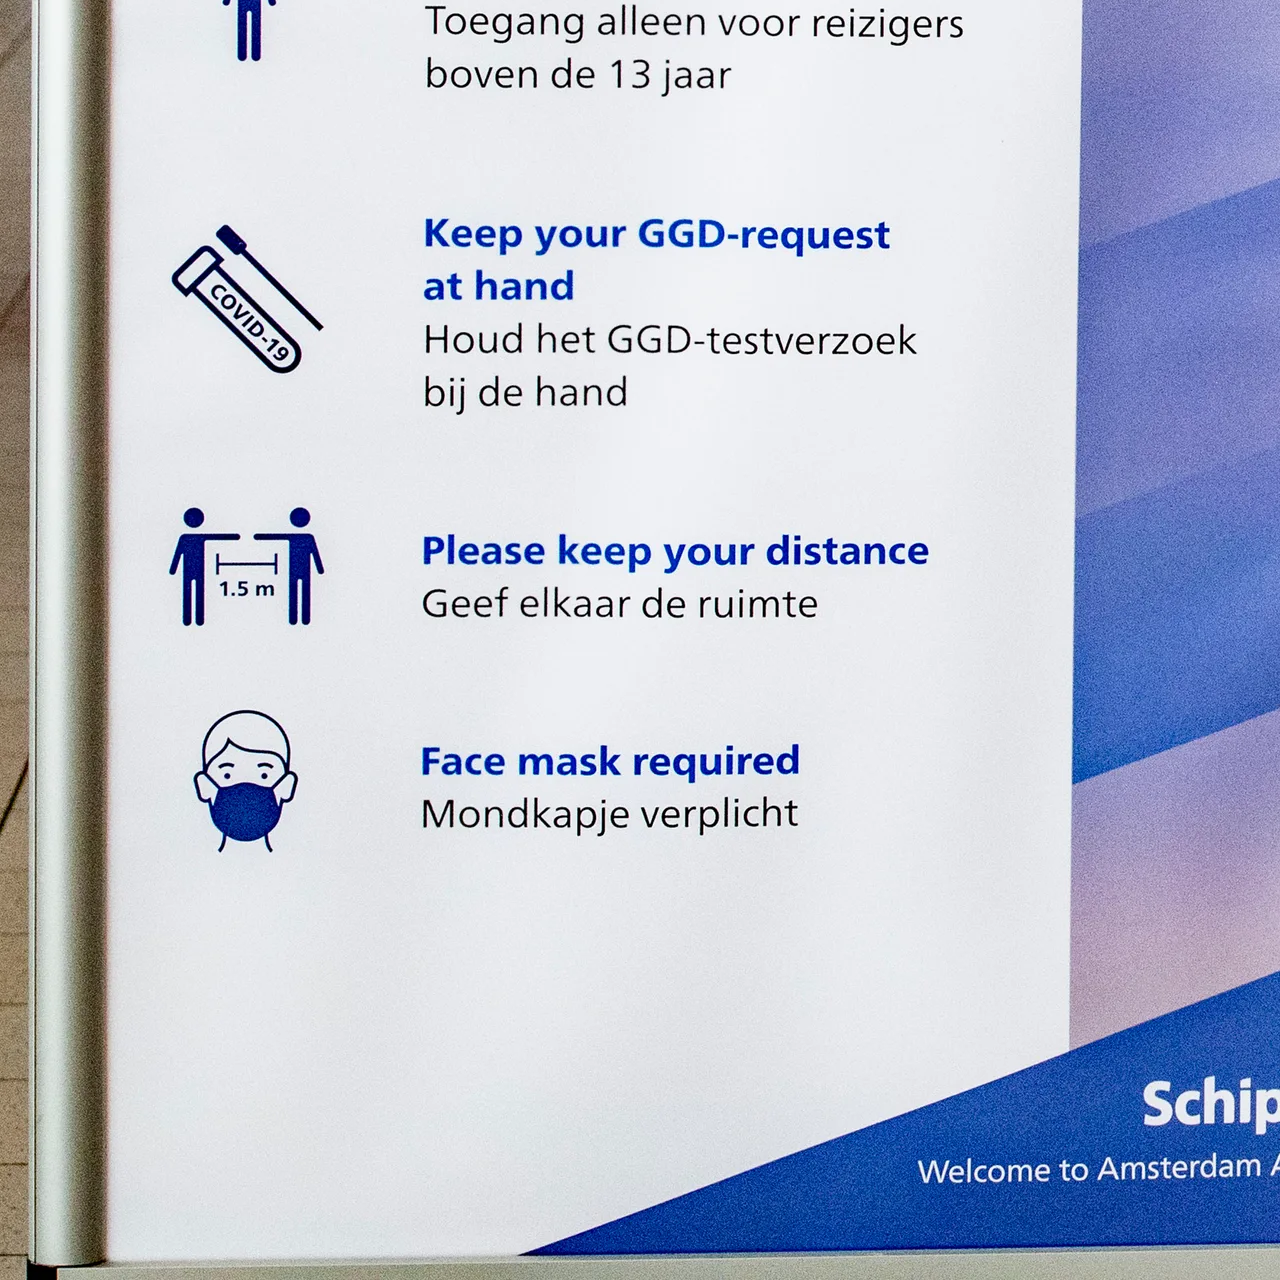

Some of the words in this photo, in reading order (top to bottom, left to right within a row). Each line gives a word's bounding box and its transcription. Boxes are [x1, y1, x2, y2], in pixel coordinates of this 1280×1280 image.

[425, 6, 583, 43] Toegang
[598, 5, 704, 35] alleen
[719, 15, 800, 36] voor
[814, 9, 963, 46] reizigers
[427, 57, 537, 88] boven
[552, 58, 594, 88] de
[612, 60, 649, 88] 13
[662, 60, 731, 97] jaar
[426, 219, 522, 255] Keep
[535, 226, 626, 255] your
[639, 219, 890, 257] GGD-request
[424, 273, 462, 300] at
[476, 270, 573, 300] hand
[210, 284, 290, 361] COVID-19
[426, 323, 522, 353] Houd
[538, 323, 595, 353] het
[609, 324, 916, 354] GGD-testverzoek
[425, 376, 464, 415] bij
[479, 376, 522, 406] de
[537, 376, 626, 406] hand
[424, 534, 544, 565] Please
[559, 534, 651, 573] keep
[664, 544, 755, 573] your
[767, 535, 928, 565] distance
[220, 581, 248, 596] 1.5
[256, 585, 274, 596] m
[423, 587, 508, 617] Geef
[521, 587, 630, 617] elkaar
[643, 587, 685, 618] de
[700, 589, 817, 618] ruimte
[423, 747, 505, 775] Face
[519, 745, 621, 775] mask
[634, 744, 798, 783] required
[423, 798, 629, 836] Mondkapje
[641, 796, 798, 835] verplicht
[918, 1158, 1050, 1183] Welcome
[1059, 1160, 1088, 1181] to
[1098, 1153, 1260, 1180] Amsterdam
